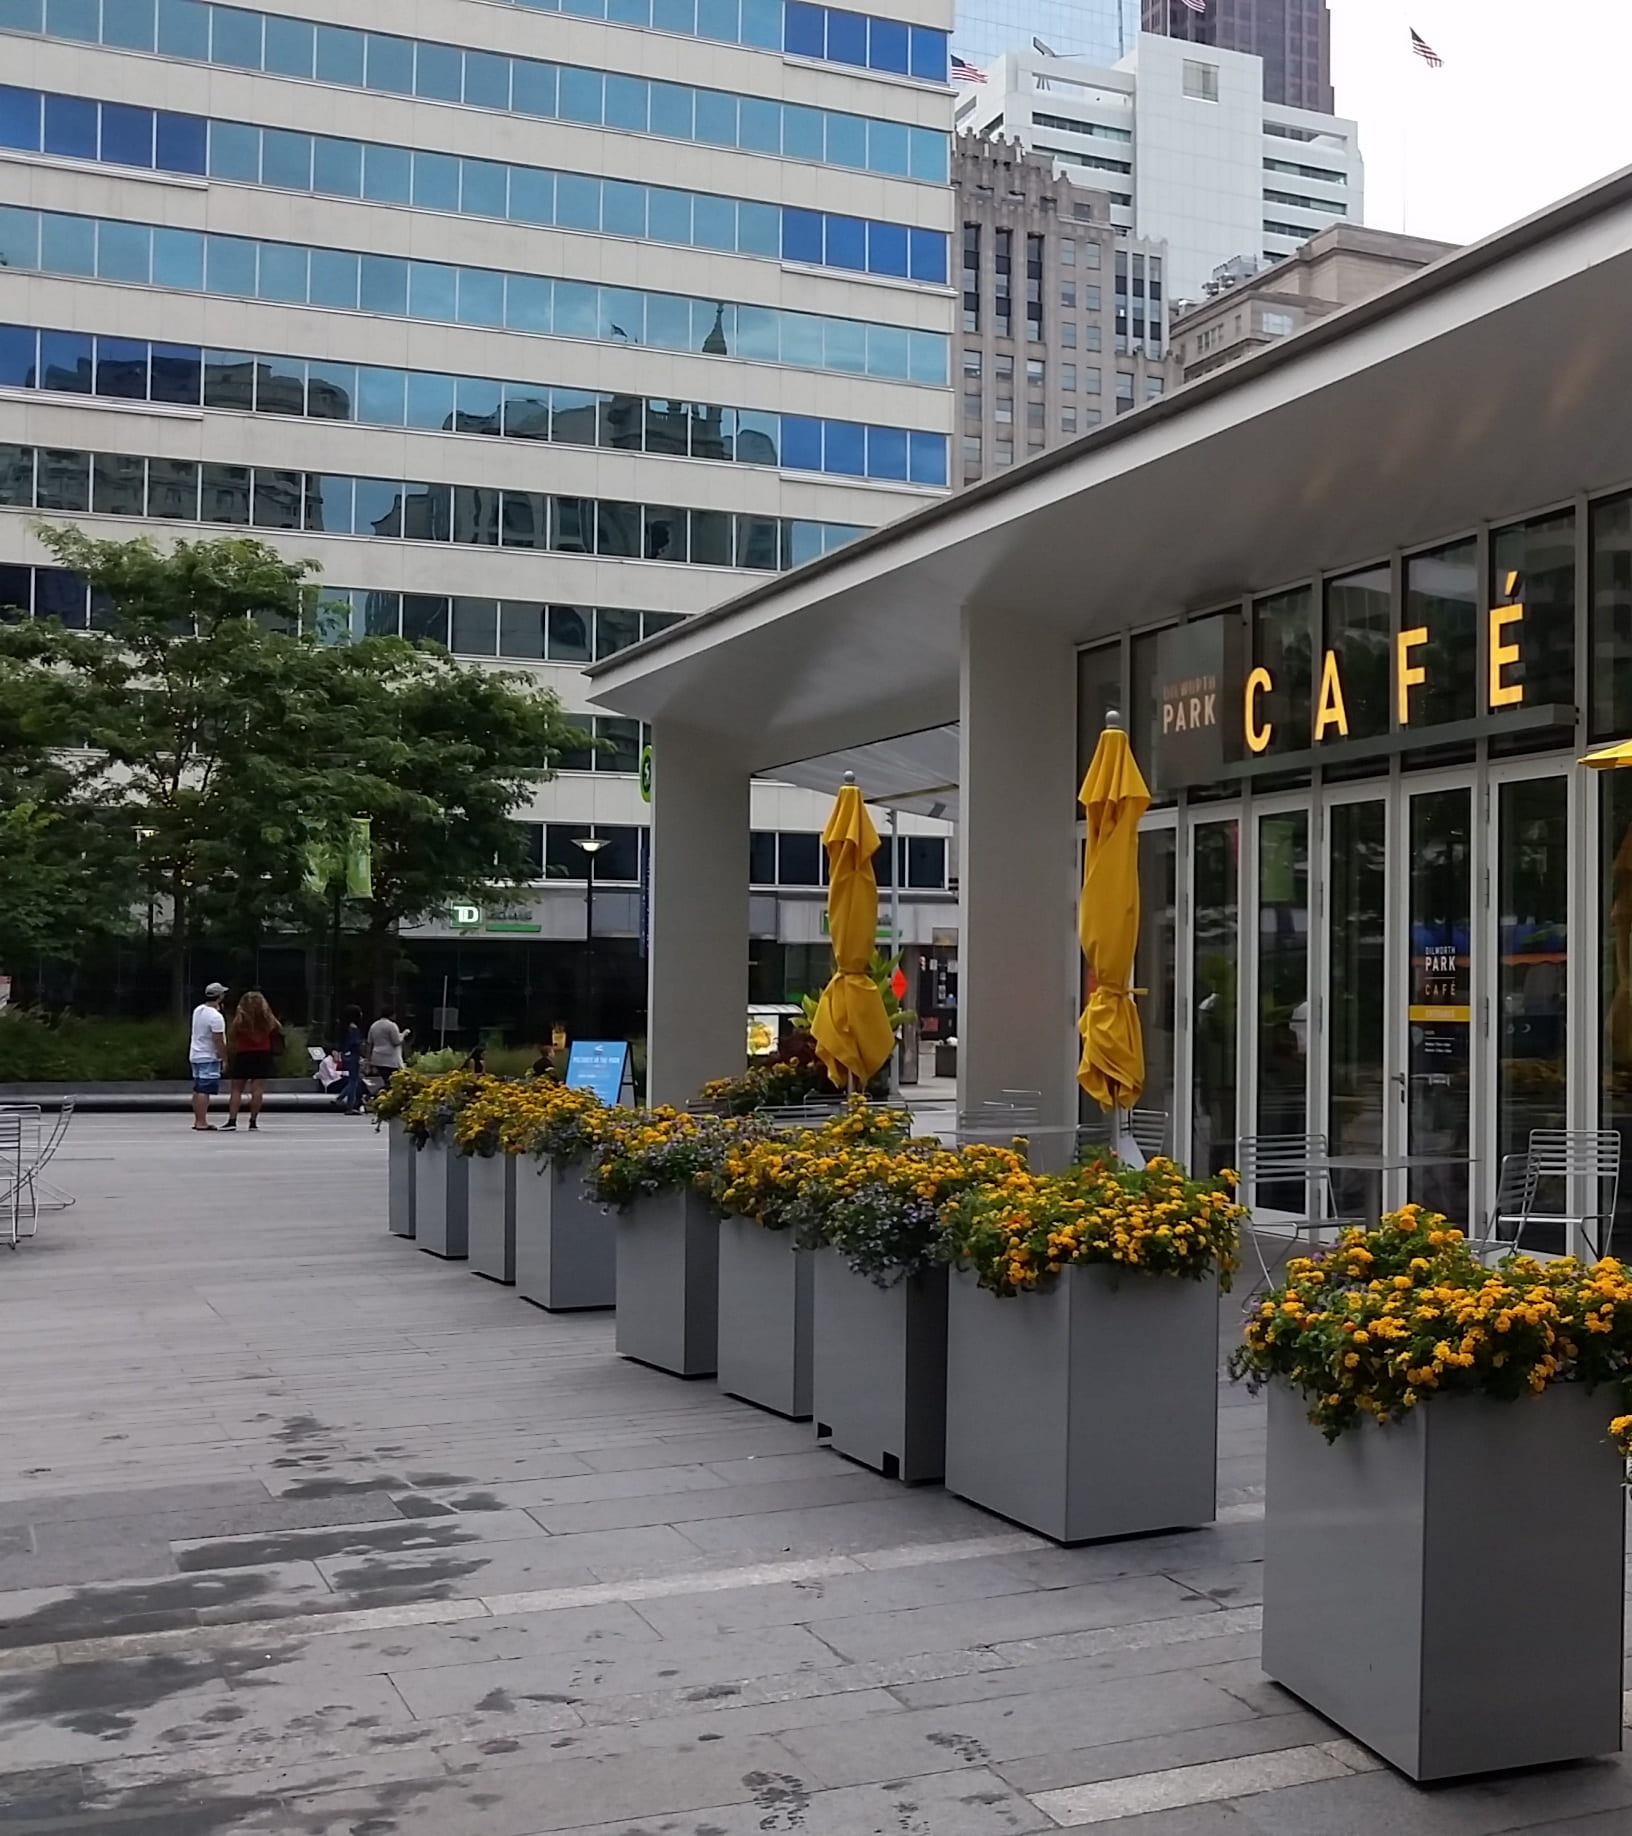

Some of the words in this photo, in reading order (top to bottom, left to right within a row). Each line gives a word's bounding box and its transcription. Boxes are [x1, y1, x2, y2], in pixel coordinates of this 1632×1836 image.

[1243, 571, 1524, 753] CAFÉ
[1163, 693, 1216, 735] PARK
[453, 906, 479, 923] TD
[1424, 955, 1456, 972] PARK
